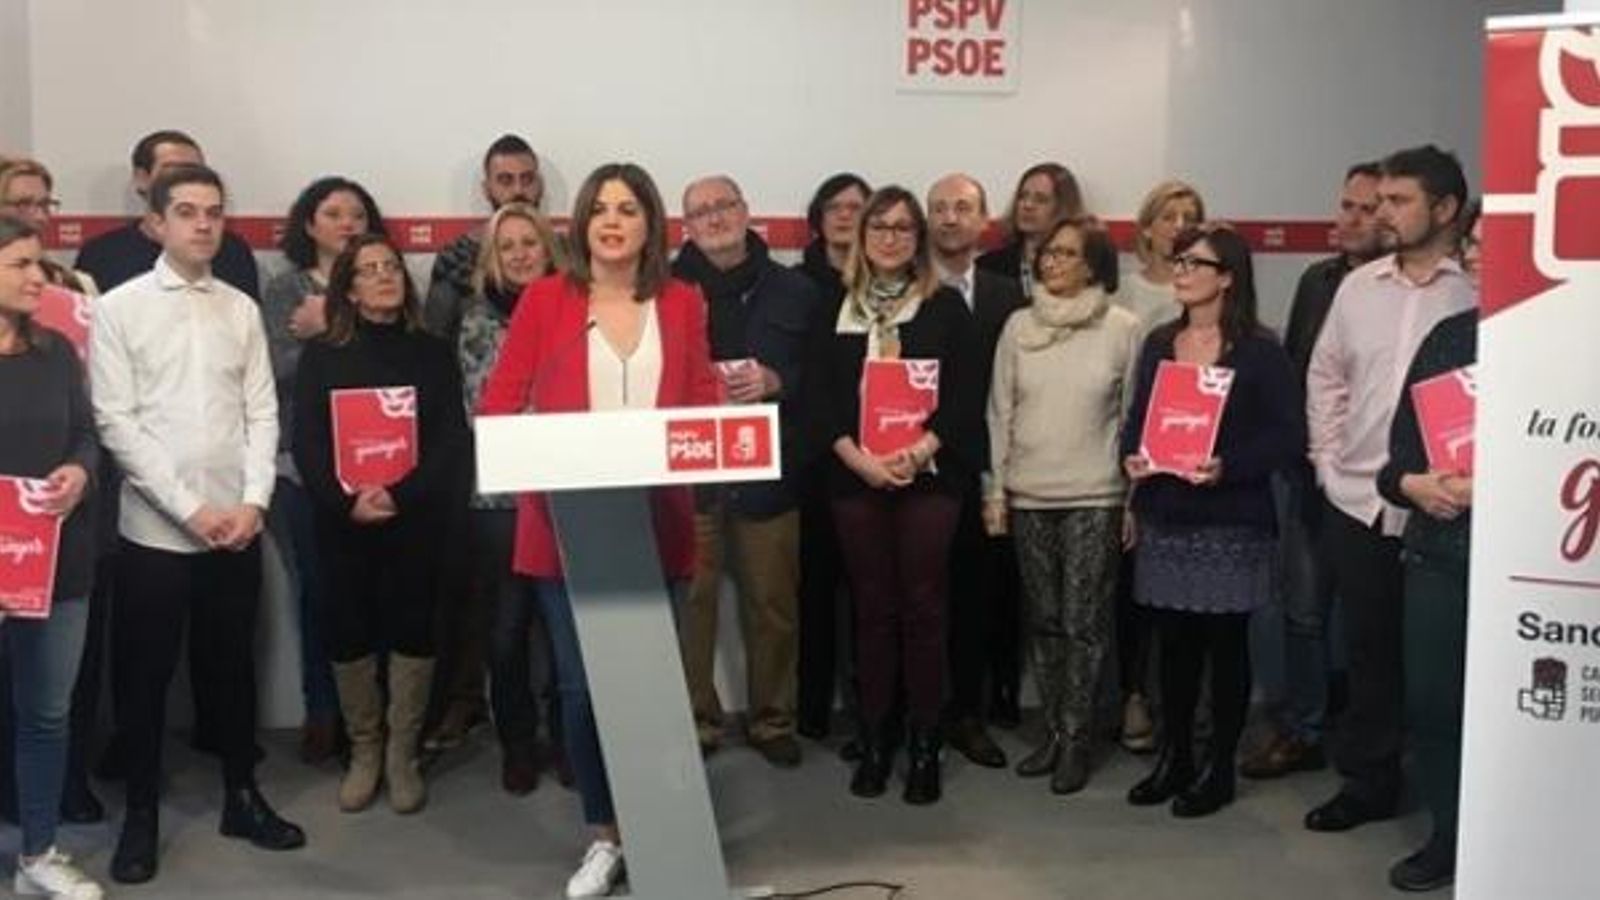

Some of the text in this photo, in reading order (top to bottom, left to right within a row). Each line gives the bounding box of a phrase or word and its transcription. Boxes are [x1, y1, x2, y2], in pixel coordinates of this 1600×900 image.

[908, 0, 1005, 30] PSPV
[907, 39, 1005, 76] PSOE
[1528, 409, 1600, 443] la fo
[669, 440, 715, 460] PSOE
